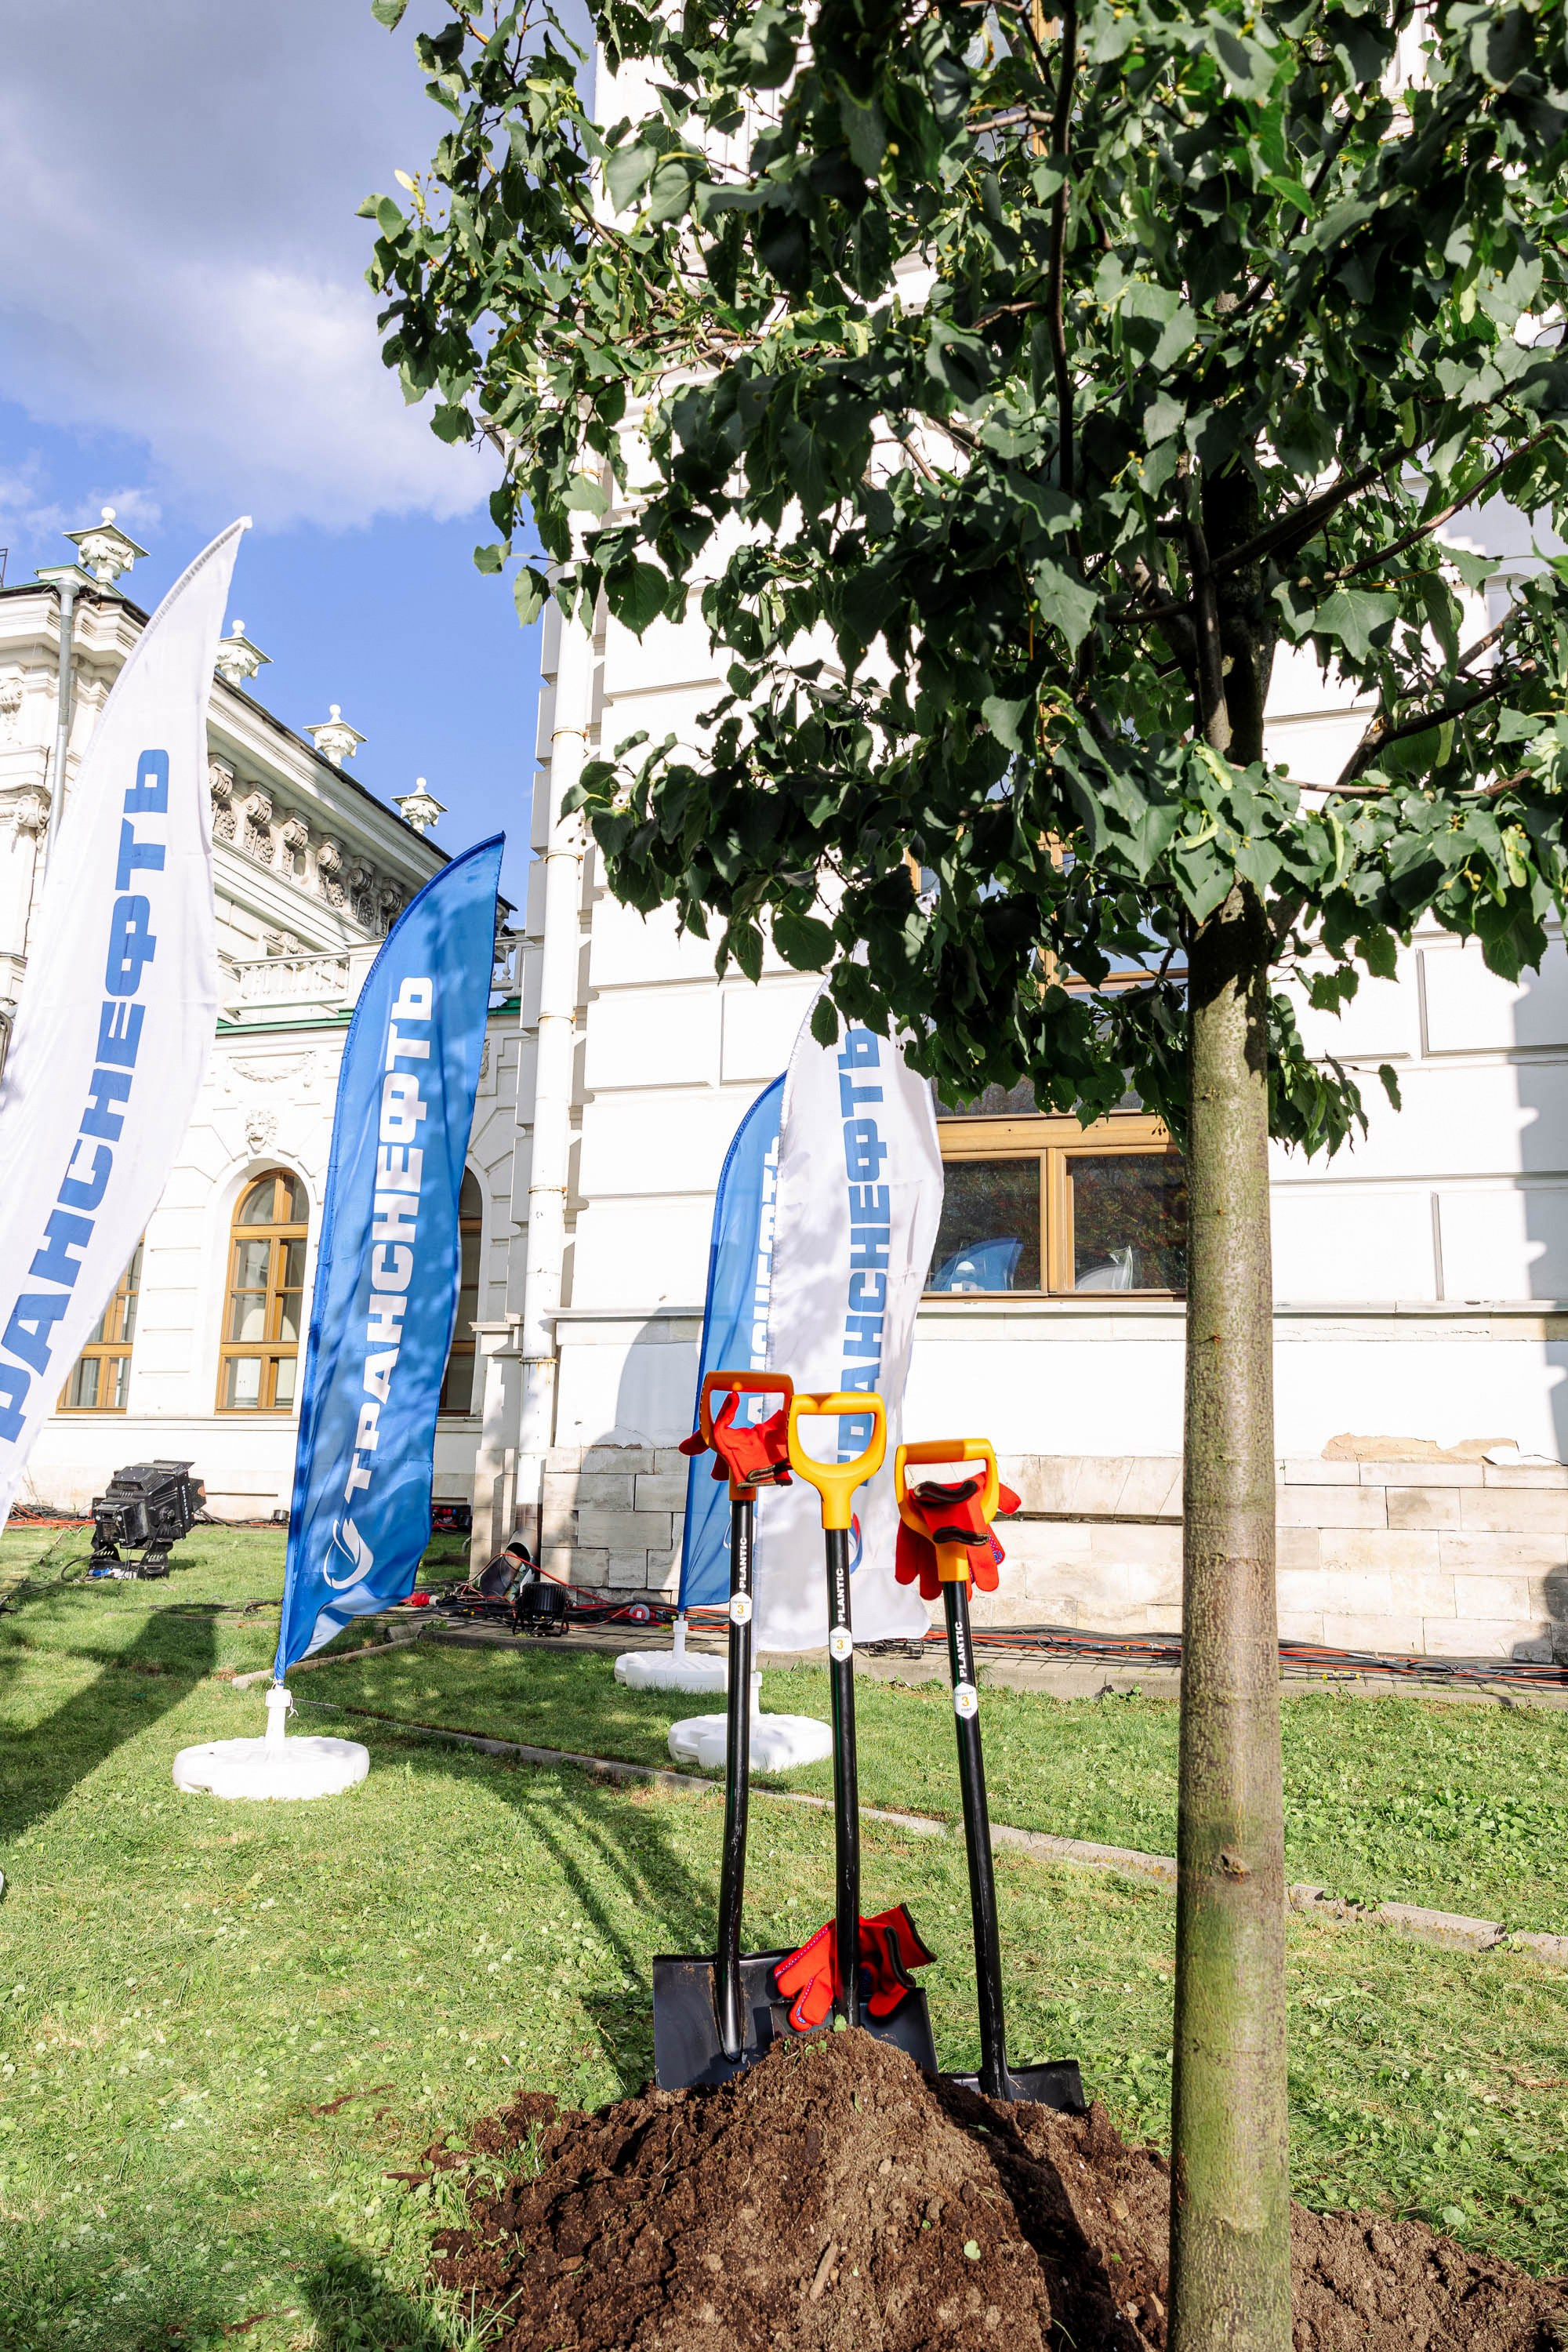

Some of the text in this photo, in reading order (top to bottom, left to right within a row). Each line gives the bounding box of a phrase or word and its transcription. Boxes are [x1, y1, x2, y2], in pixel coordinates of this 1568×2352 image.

[0, 749, 169, 1443] РАНСНЕФТЬ
[343, 977, 434, 1504] ТРАНСНЕФТЬ
[837, 1028, 891, 1486] РАНСНЕФТЬ
[739, 1537, 747, 1588] PLANTIC
[737, 1604, 744, 1614] 3
[836, 1567, 845, 1622] PLANTIC
[837, 1639, 844, 1650] 3
[954, 1621, 967, 1678] PLANTIC
[961, 1696, 970, 1707] 3
